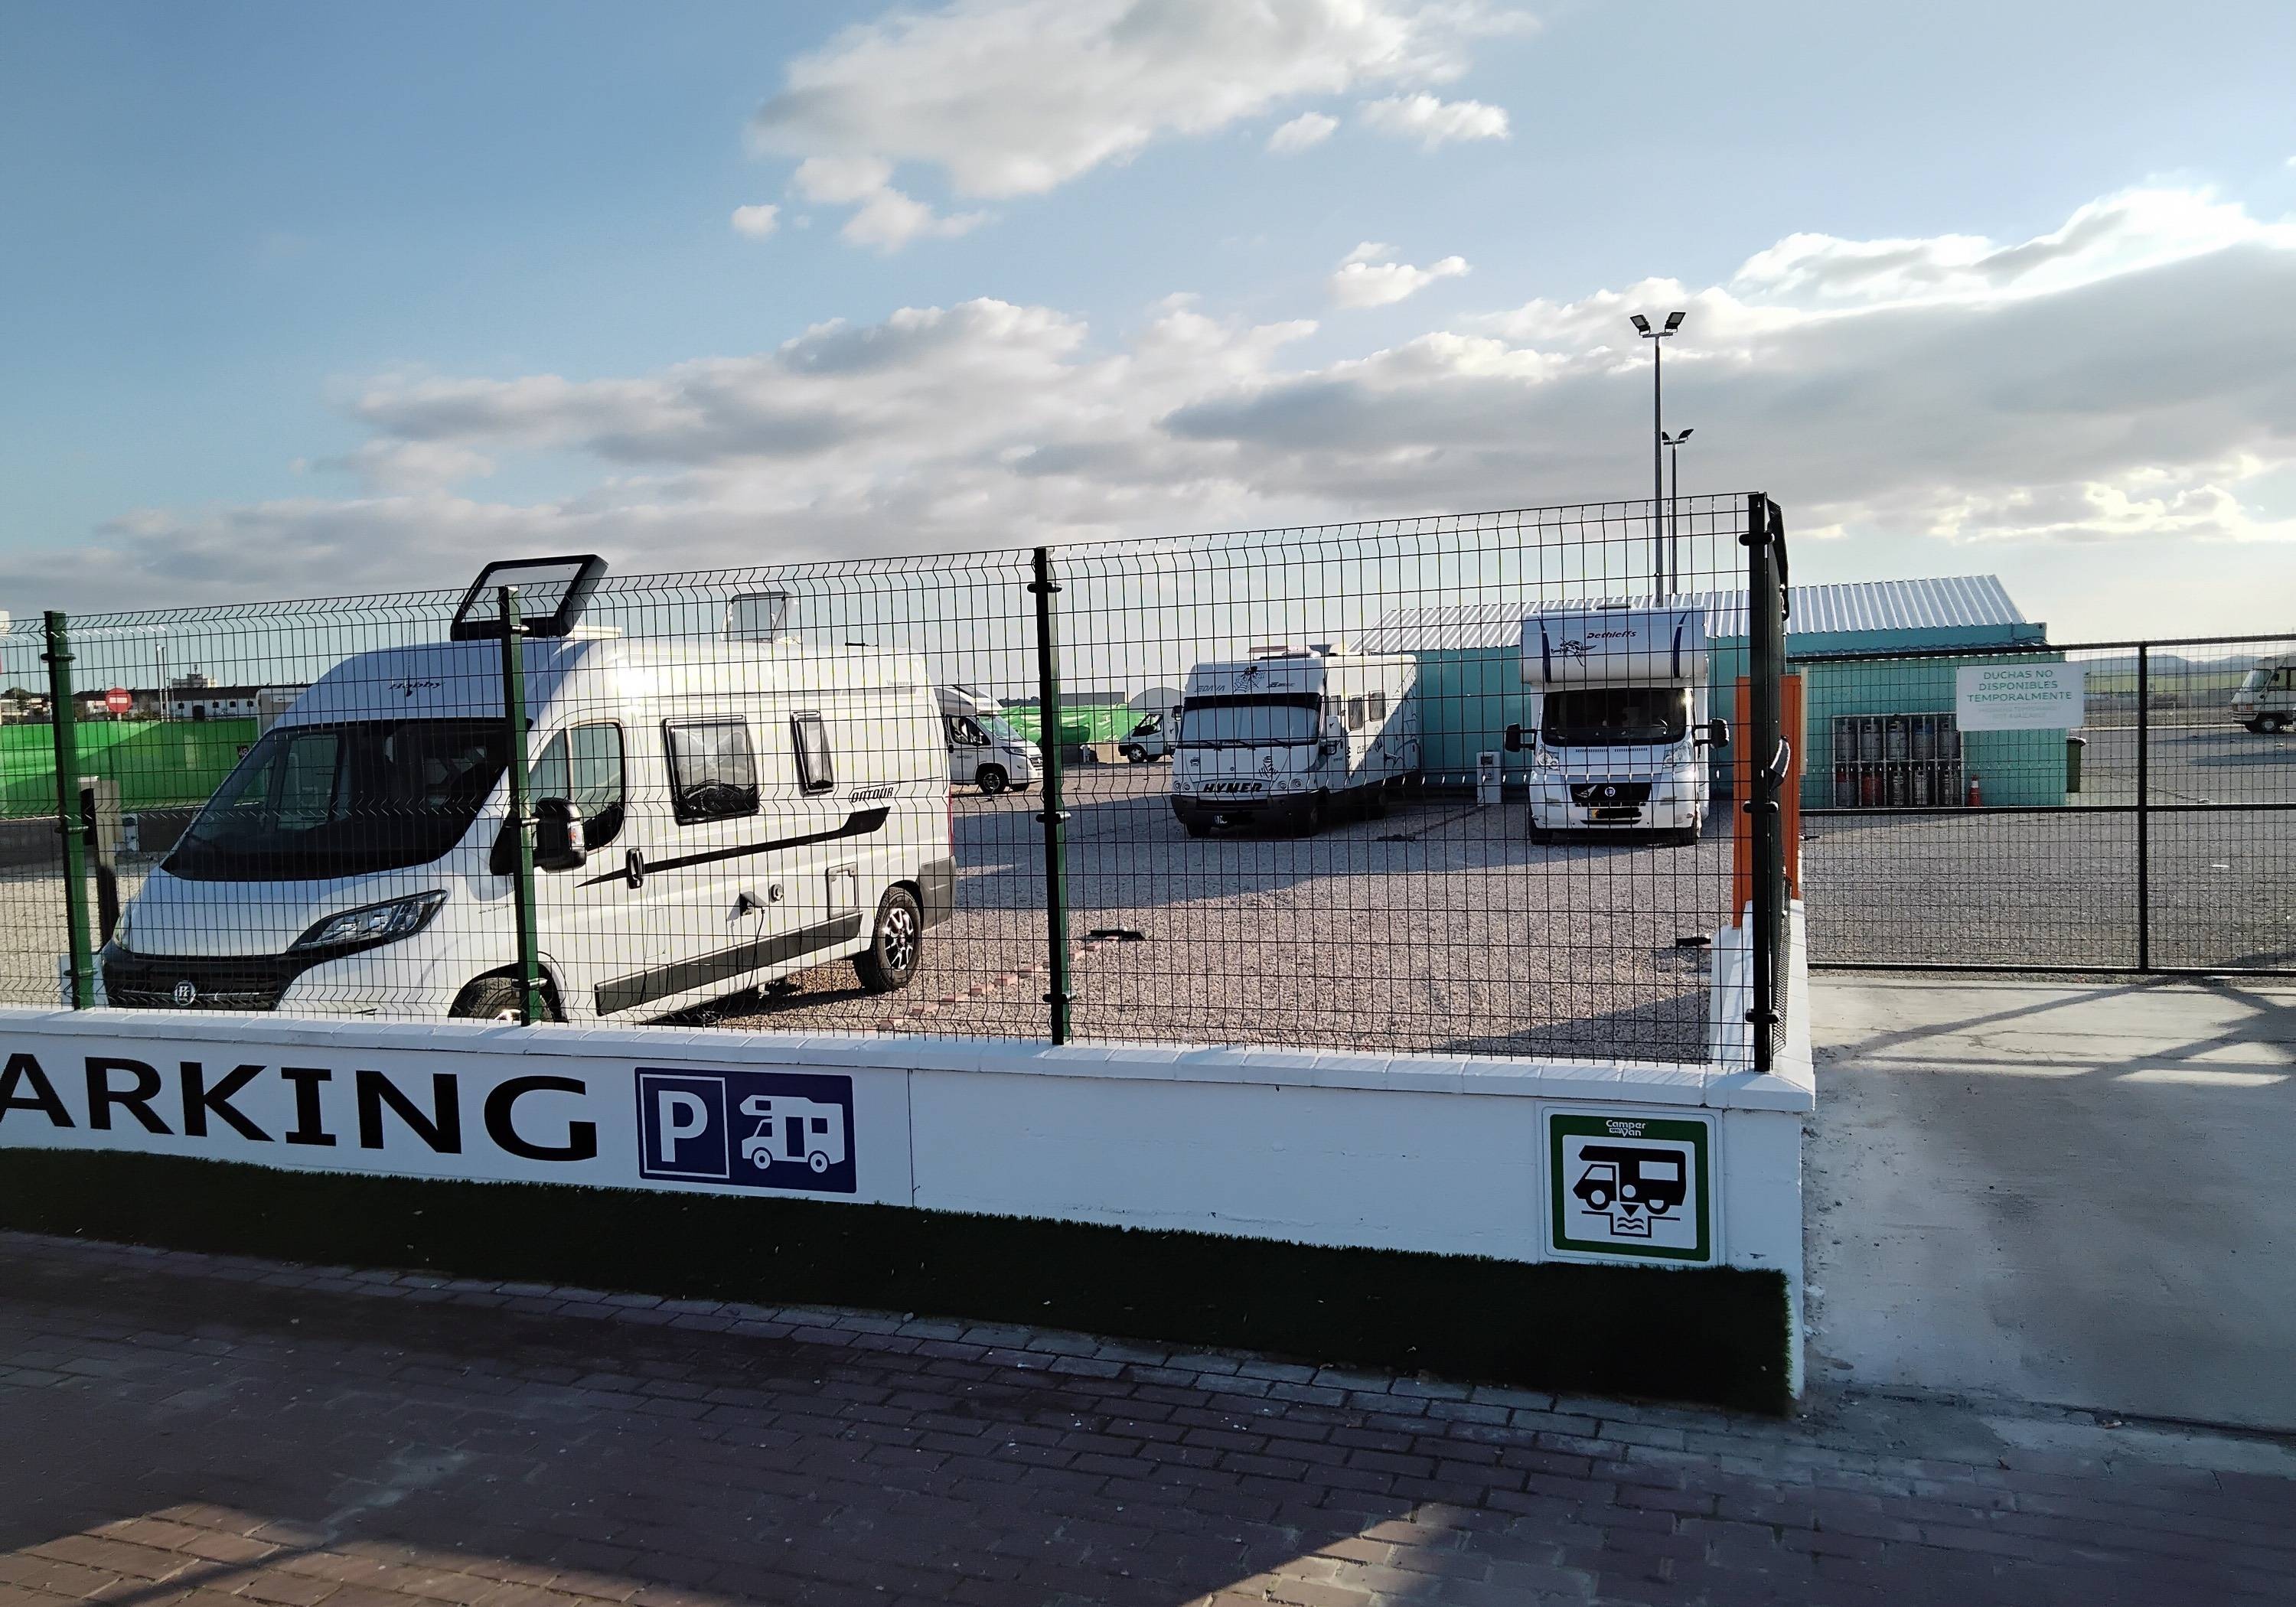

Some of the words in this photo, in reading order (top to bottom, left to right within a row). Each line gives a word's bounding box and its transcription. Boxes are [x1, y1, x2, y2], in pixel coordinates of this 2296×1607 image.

[1984, 670, 2032, 680] DUCHAS
[2036, 670, 2053, 678] NO
[1979, 680, 2058, 691] DISPONIBLES
[1967, 691, 2072, 702] TEMPORALMENTE
[1203, 782, 1263, 794] HYMER
[657, 1090, 708, 1162] P
[1606, 1120, 1646, 1130] Camper
[1620, 1127, 1642, 1138] Van
